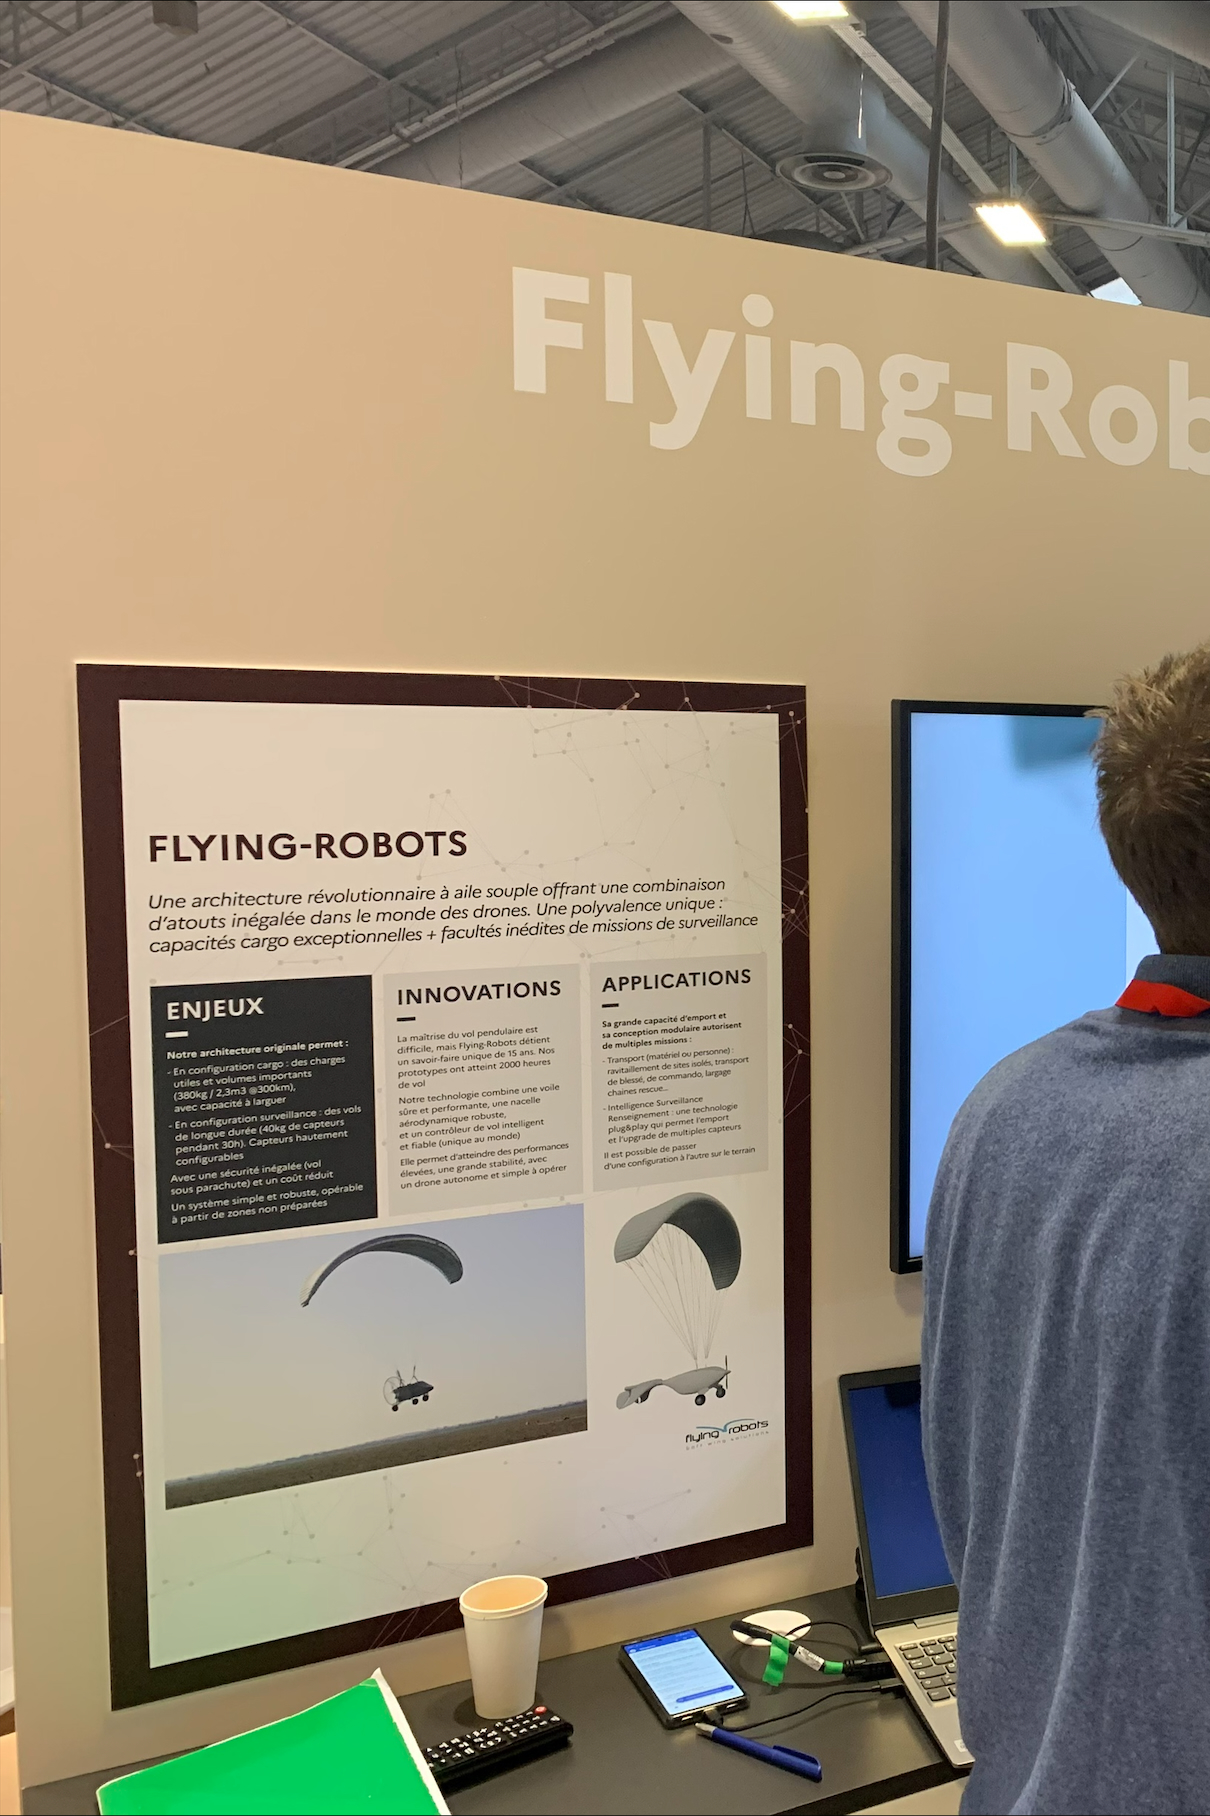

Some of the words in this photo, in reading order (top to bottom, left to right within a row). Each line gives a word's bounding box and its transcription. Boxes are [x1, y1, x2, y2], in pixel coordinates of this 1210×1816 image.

[149, 830, 467, 863] FLYING-ROBOTS
[149, 895, 187, 910] Une
[191, 891, 303, 908] architecture
[307, 886, 436, 904] révolutionnaire
[440, 885, 450, 900] à
[454, 884, 482, 899] aile
[486, 883, 539, 902] souple
[542, 881, 597, 900] offrant
[600, 883, 629, 894] une
[632, 877, 726, 893] combinaison
[148, 915, 227, 932] d'atouts
[231, 911, 306, 932] inégalée
[310, 910, 352, 925] dans
[356, 908, 372, 923] le
[376, 906, 436, 922] monde
[440, 905, 469, 920] des
[473, 904, 531, 919] drones.
[537, 902, 568, 916] Une
[570, 899, 662, 919] polyvalence
[665, 897, 716, 914] unique
[149, 934, 236, 957] capacités
[240, 936, 289, 952] cargo
[293, 927, 423, 949] exceptionnelles
[441, 923, 502, 944] facultés
[505, 921, 566, 937] inédites
[569, 920, 589, 934] de
[592, 918, 653, 933] missions
[656, 916, 675, 931] de
[678, 914, 759, 929] surveillance
[602, 969, 752, 993] APPLICATIONS
[397, 980, 561, 1005] INNOVATIONS
[166, 997, 264, 1022] ENJEUX
[602, 1020, 612, 1028] Sa
[613, 1018, 642, 1029] grande
[643, 1015, 678, 1026] capacité
[612, 1029, 659, 1038] conception
[660, 1025, 701, 1034] modulaire
[702, 1022, 742, 1031] autorisent
[397, 1035, 408, 1043] La
[409, 1033, 446, 1042] maîtrise
[447, 1031, 460, 1040] du
[461, 1030, 475, 1038] vol
[477, 1027, 524, 1039] pendulaire
[525, 1026, 538, 1034] est
[459, 1039, 518, 1052] Flying-Robots
[519, 1037, 550, 1046] détient
[602, 1042, 613, 1050] de
[614, 1039, 653, 1049] multiples
[654, 1037, 688, 1046] missions
[167, 1051, 198, 1060] Notre
[199, 1047, 262, 1058] architecture
[263, 1042, 306, 1054] originale
[308, 1040, 344, 1052] permet
[397, 1059, 410, 1067] un
[411, 1054, 460, 1065] savoir-faire
[462, 1053, 493, 1062] unique
[494, 1050, 506, 1059] de
[507, 1049, 518, 1058] 15
[538, 1047, 556, 1055] Nos
[173, 1067, 187, 1077] En
[188, 1063, 255, 1076] configuration
[256, 1061, 285, 1071] cargo
[290, 1058, 308, 1067] des
[309, 1056, 346, 1066] charges
[398, 1068, 448, 1080] prototypes
[449, 1066, 465, 1074] ont
[467, 1063, 497, 1072] atteint
[499, 1060, 521, 1070] 2000
[522, 1059, 551, 1067] heures
[173, 1078, 201, 1089] utiles
[202, 1078, 214, 1086] et
[215, 1075, 257, 1085] volumes
[259, 1071, 313, 1083] importants
[397, 1081, 411, 1090] de
[411, 1079, 426, 1088] vol
[398, 1097, 425, 1105] Notre
[427, 1091, 480, 1103] technologie
[481, 1088, 520, 1098] combine
[539, 1083, 560, 1092] voile
[608, 1101, 655, 1112] Intelligence
[656, 1097, 704, 1107] Surveillance
[174, 1104, 198, 1113] avec
[200, 1098, 243, 1112] capacité
[244, 1098, 251, 1107] à
[253, 1097, 287, 1108] larguer
[175, 1120, 188, 1130] En
[189, 1115, 258, 1128] configuration
[260, 1110, 317, 1122] surveillance
[324, 1107, 342, 1116] des
[342, 1105, 362, 1114] vols
[608, 1123, 649, 1135] plug&play
[650, 1122, 664, 1131] qui
[665, 1118, 694, 1129] permet
[175, 1133, 189, 1142] de
[191, 1131, 226, 1141] longue
[227, 1126, 257, 1137] durée
[288, 1122, 301, 1131] de
[302, 1119, 345, 1131] capteurs
[175, 1142, 220, 1156] pendant
[248, 1136, 294, 1148] Capteurs
[295, 1130, 349, 1142] hautement
[175, 1152, 245, 1167] configurables
[170, 1174, 196, 1183] Avec
[198, 1172, 218, 1181] une
[220, 1166, 260, 1178] sécurité
[261, 1162, 302, 1175] inégalée
[170, 1186, 194, 1196] sous
[252, 1179, 264, 1187] et
[265, 1178, 279, 1186] un
[280, 1173, 303, 1184] coût
[305, 1170, 334, 1181] réduit
[171, 1203, 186, 1212] Un
[188, 1199, 230, 1212] système
[232, 1194, 265, 1206] simple
[266, 1193, 278, 1202] et
[321, 1183, 364, 1197] opérable
[171, 1216, 178, 1224] à
[180, 1212, 209, 1226] partir
[211, 1211, 225, 1220] de
[227, 1208, 257, 1218] zones
[258, 1206, 278, 1214] non
[280, 1199, 328, 1214] préparées
[685, 1430, 720, 1443] flying
[728, 1420, 769, 1435] robots
